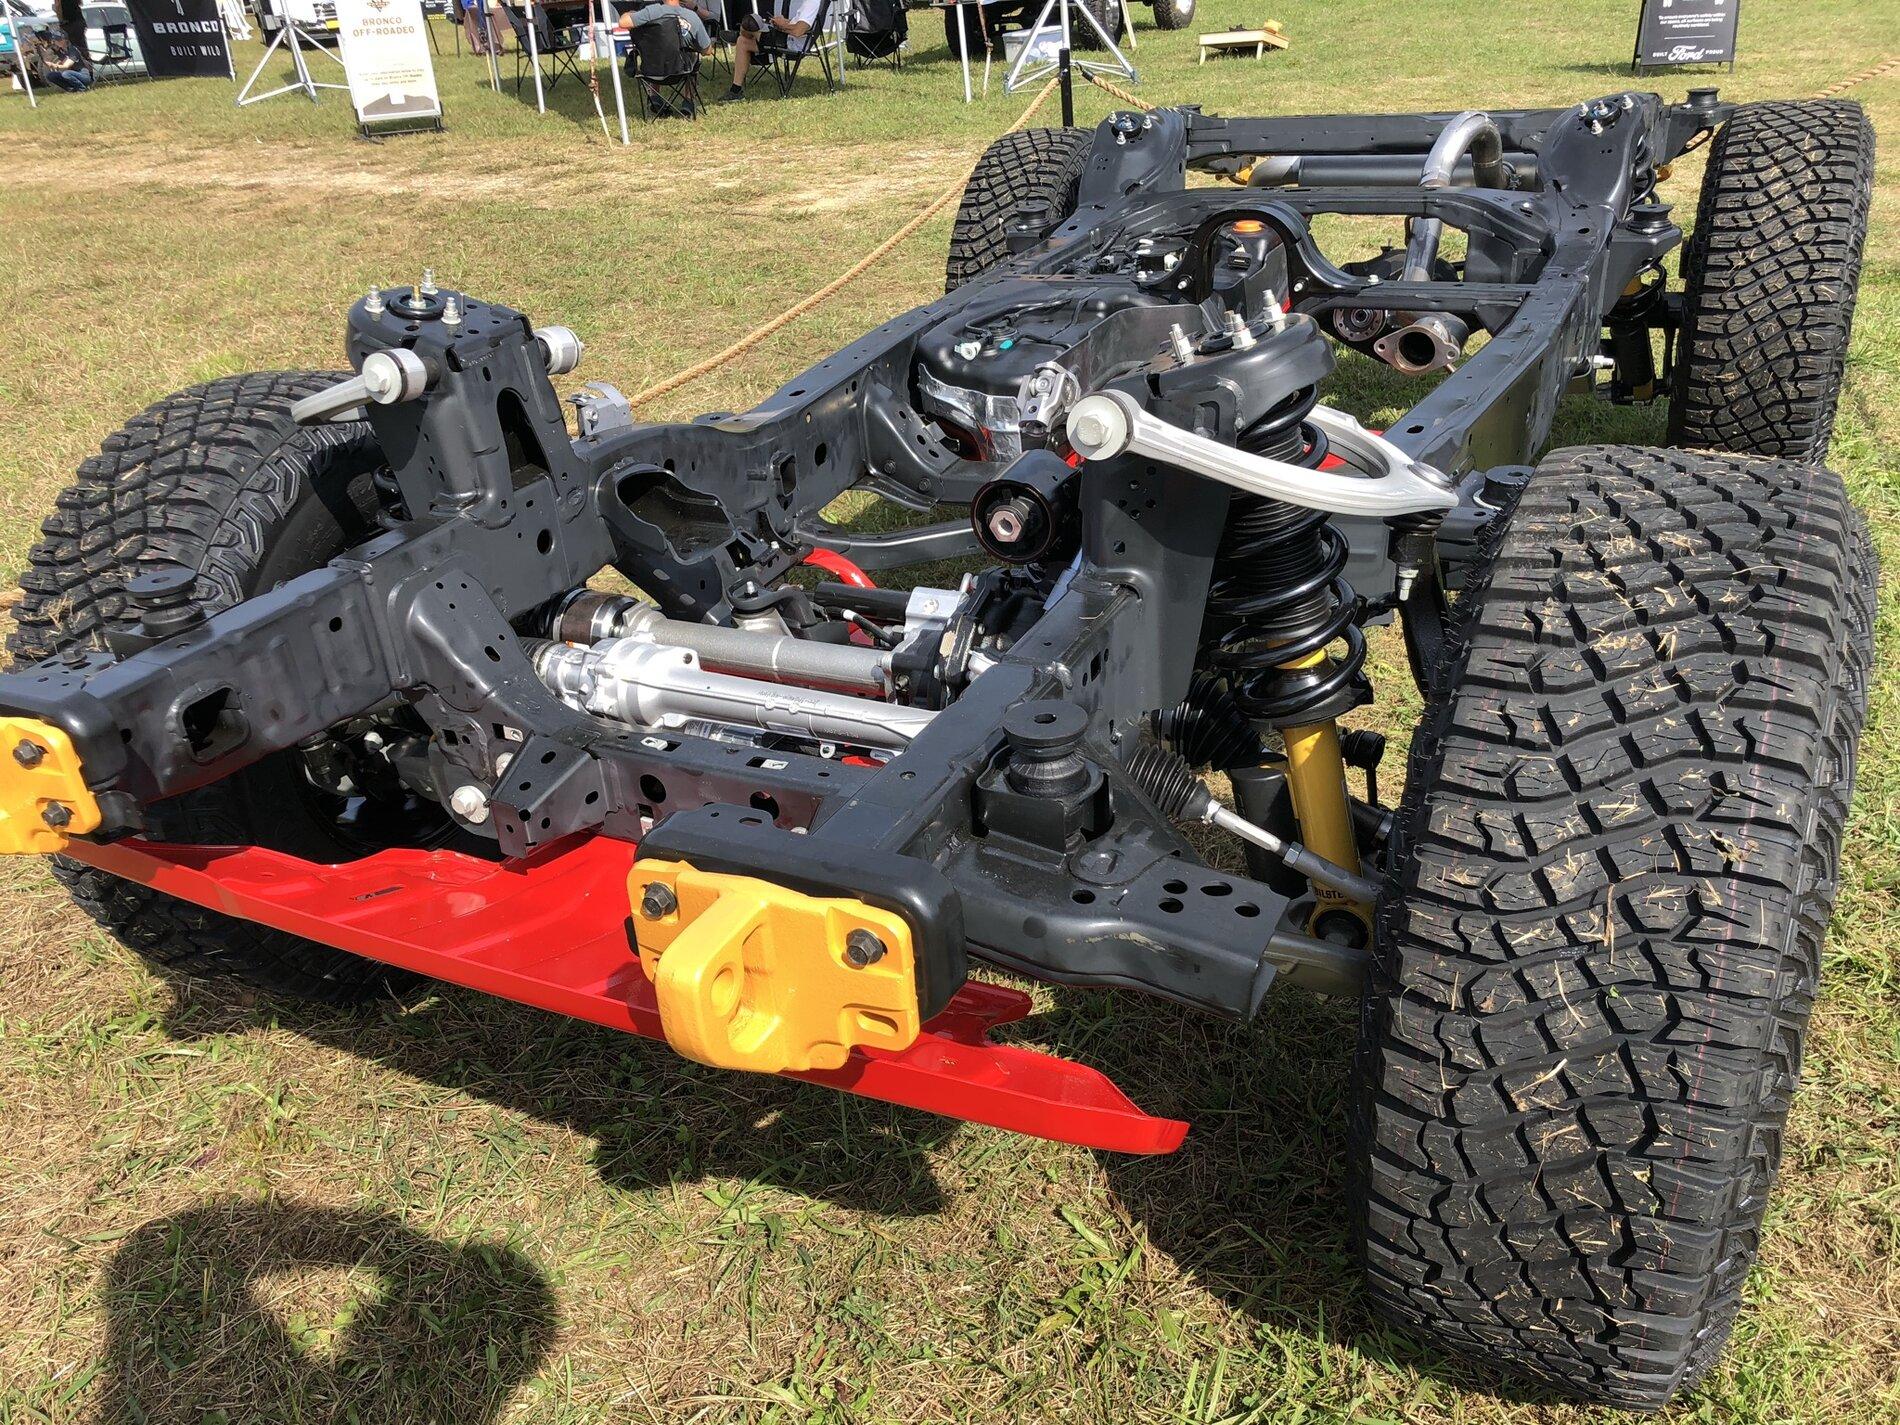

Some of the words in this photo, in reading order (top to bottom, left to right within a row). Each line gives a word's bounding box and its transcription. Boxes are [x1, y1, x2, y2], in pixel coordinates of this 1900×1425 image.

[153, 20, 219, 33] BRONCO
[362, 17, 402, 26] BRONCO
[353, 26, 415, 37] OFF-ROADEO
[170, 45, 197, 56] BUILT
[200, 45, 221, 56] WILD
[1668, 45, 1705, 60] Ford
[1314, 887, 1347, 898] BILSTE
